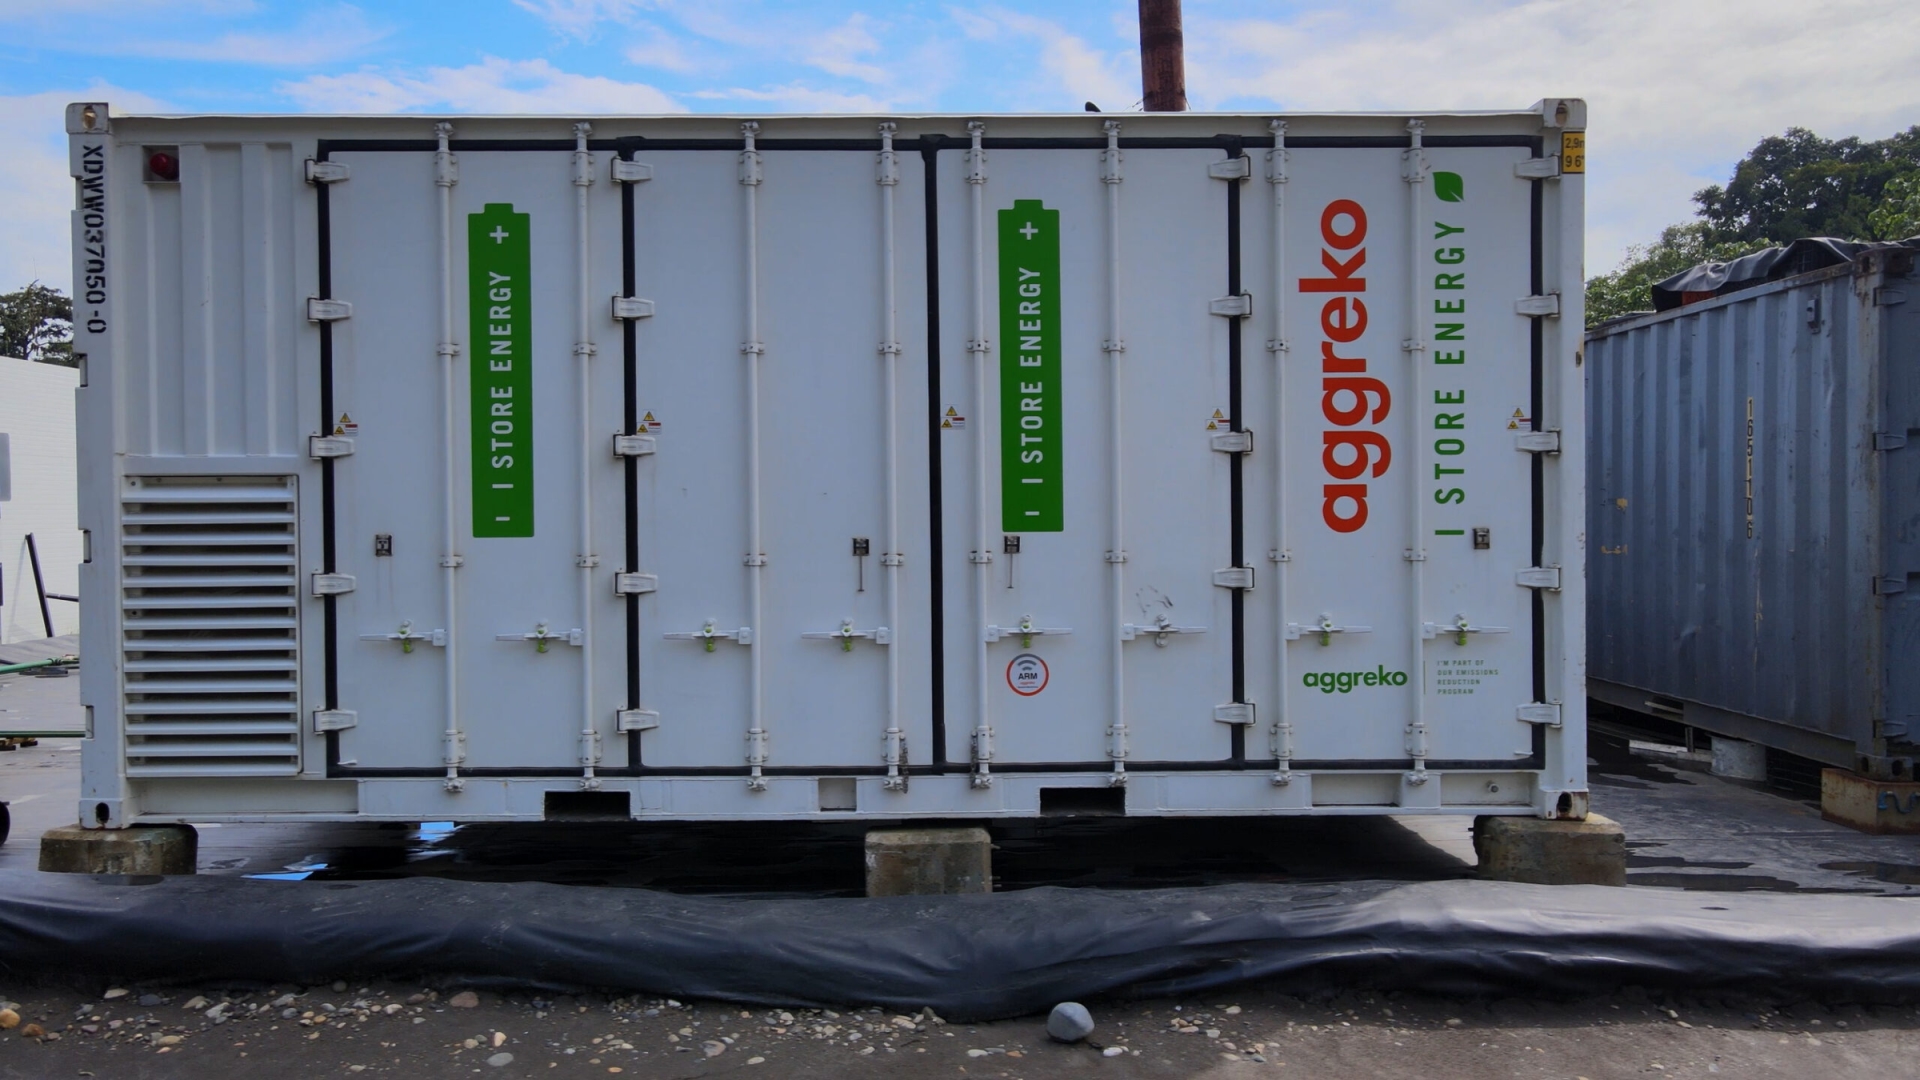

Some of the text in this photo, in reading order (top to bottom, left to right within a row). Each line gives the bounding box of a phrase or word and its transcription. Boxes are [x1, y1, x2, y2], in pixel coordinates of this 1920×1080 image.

[489, 271, 513, 372] ENERGY
[1018, 267, 1042, 367] ENERGY
[1434, 222, 1465, 365] ENERGY
[1299, 199, 1391, 533] aggreko
[490, 386, 514, 469] STORE
[1020, 381, 1044, 464] STORE
[1435, 390, 1465, 504] STORE
[1017, 672, 1038, 680] ARM
[1303, 665, 1408, 694] aggreko
